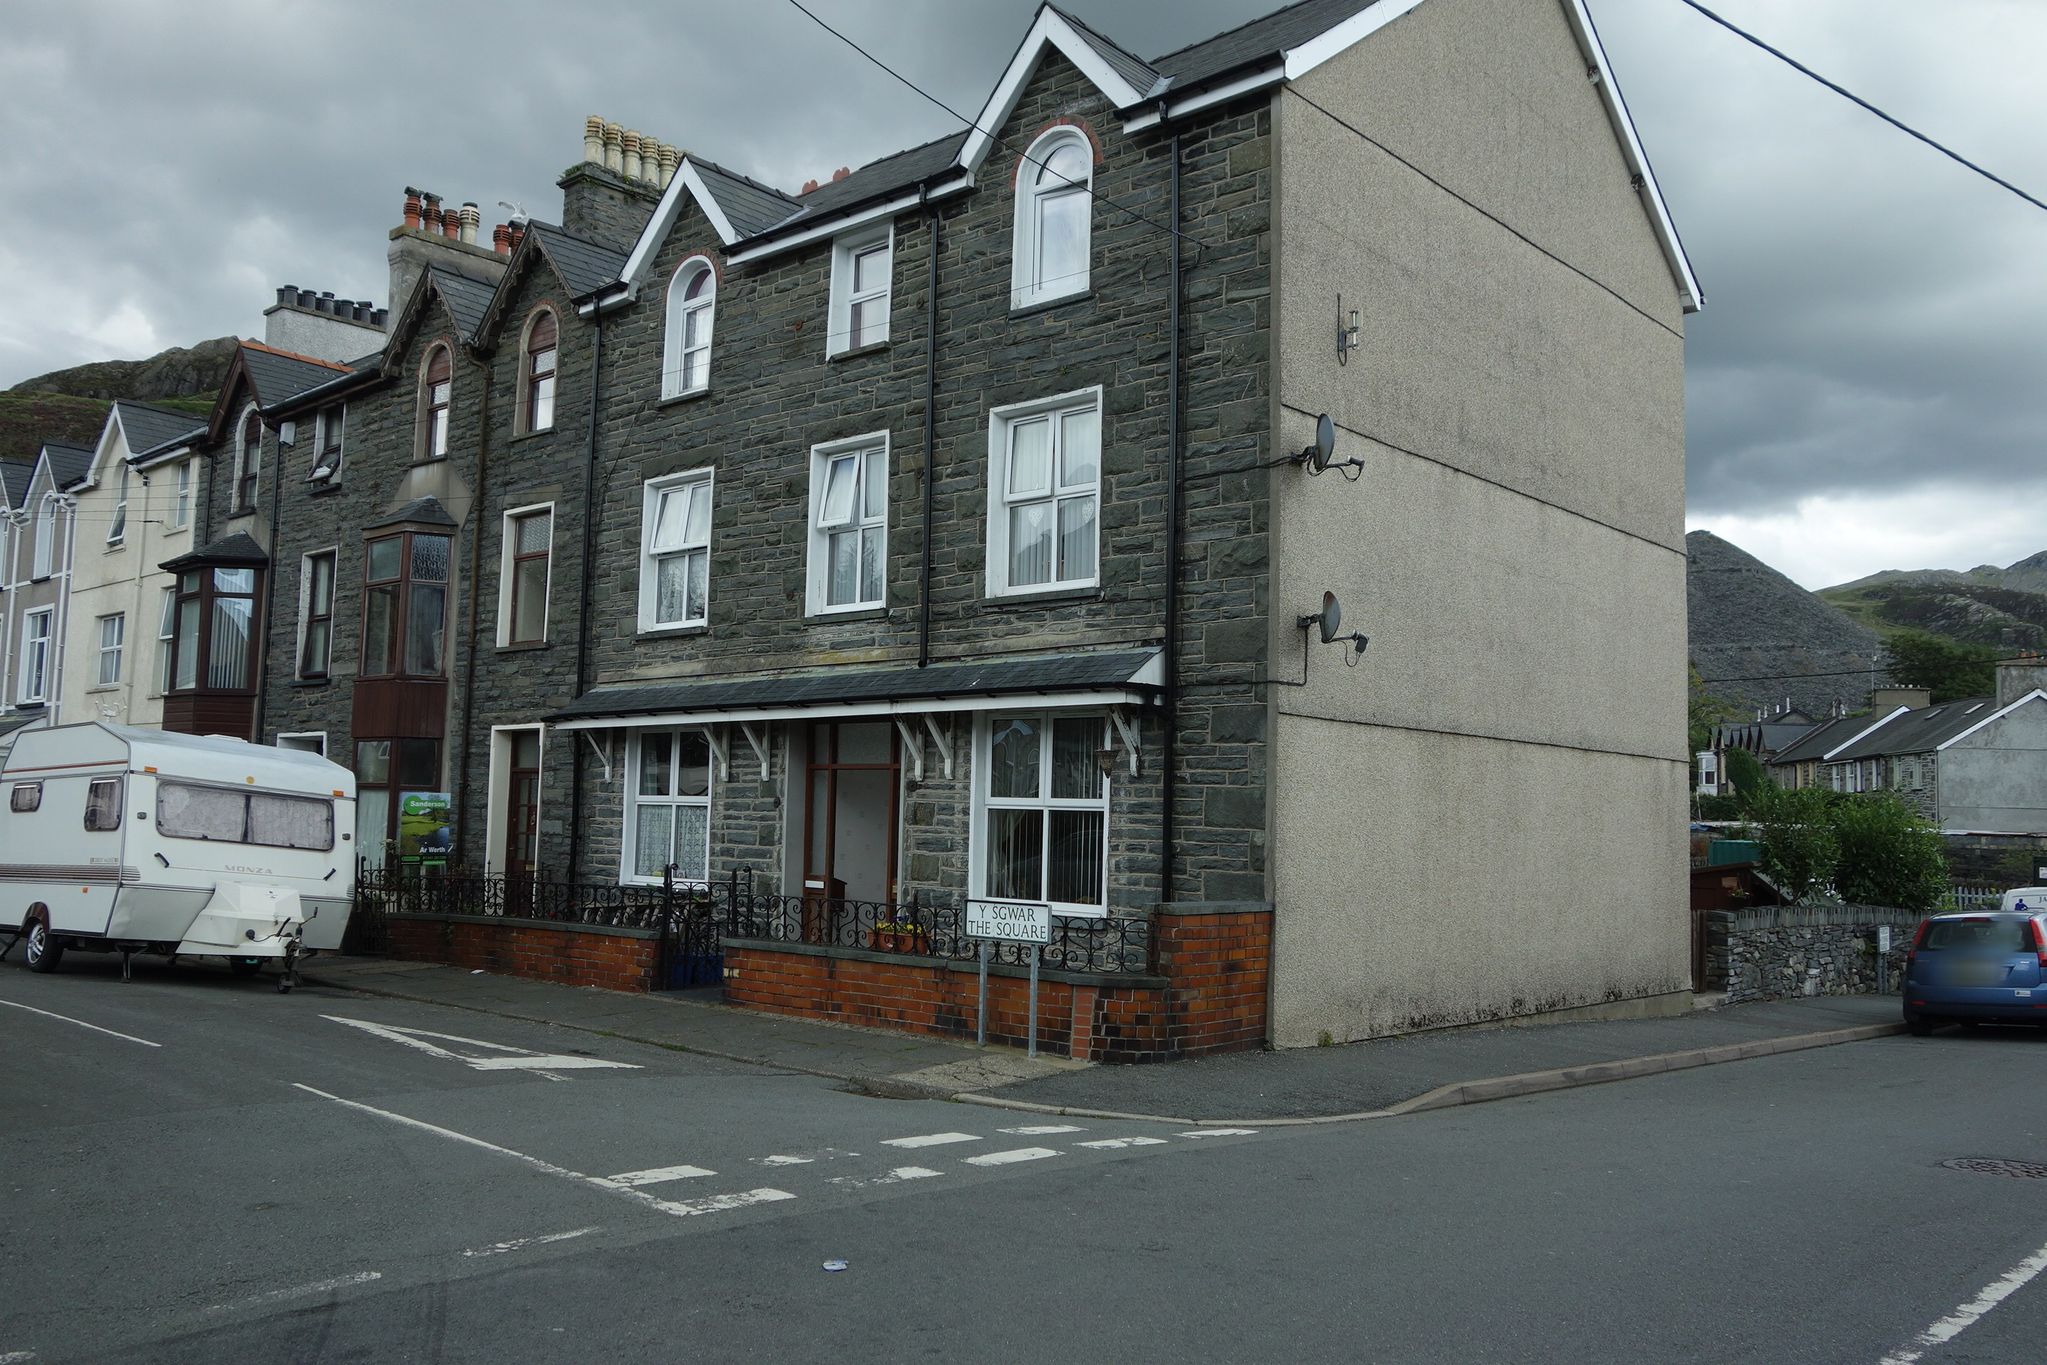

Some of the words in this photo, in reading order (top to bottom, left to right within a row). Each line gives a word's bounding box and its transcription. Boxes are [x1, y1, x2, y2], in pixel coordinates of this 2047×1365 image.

[429, 845, 446, 853] Werth
[224, 864, 272, 874] MONZA
[979, 904, 987, 919] Y
[992, 905, 1035, 921] SGWAR
[968, 920, 991, 935] THE
[996, 921, 1046, 939] SQUARE
